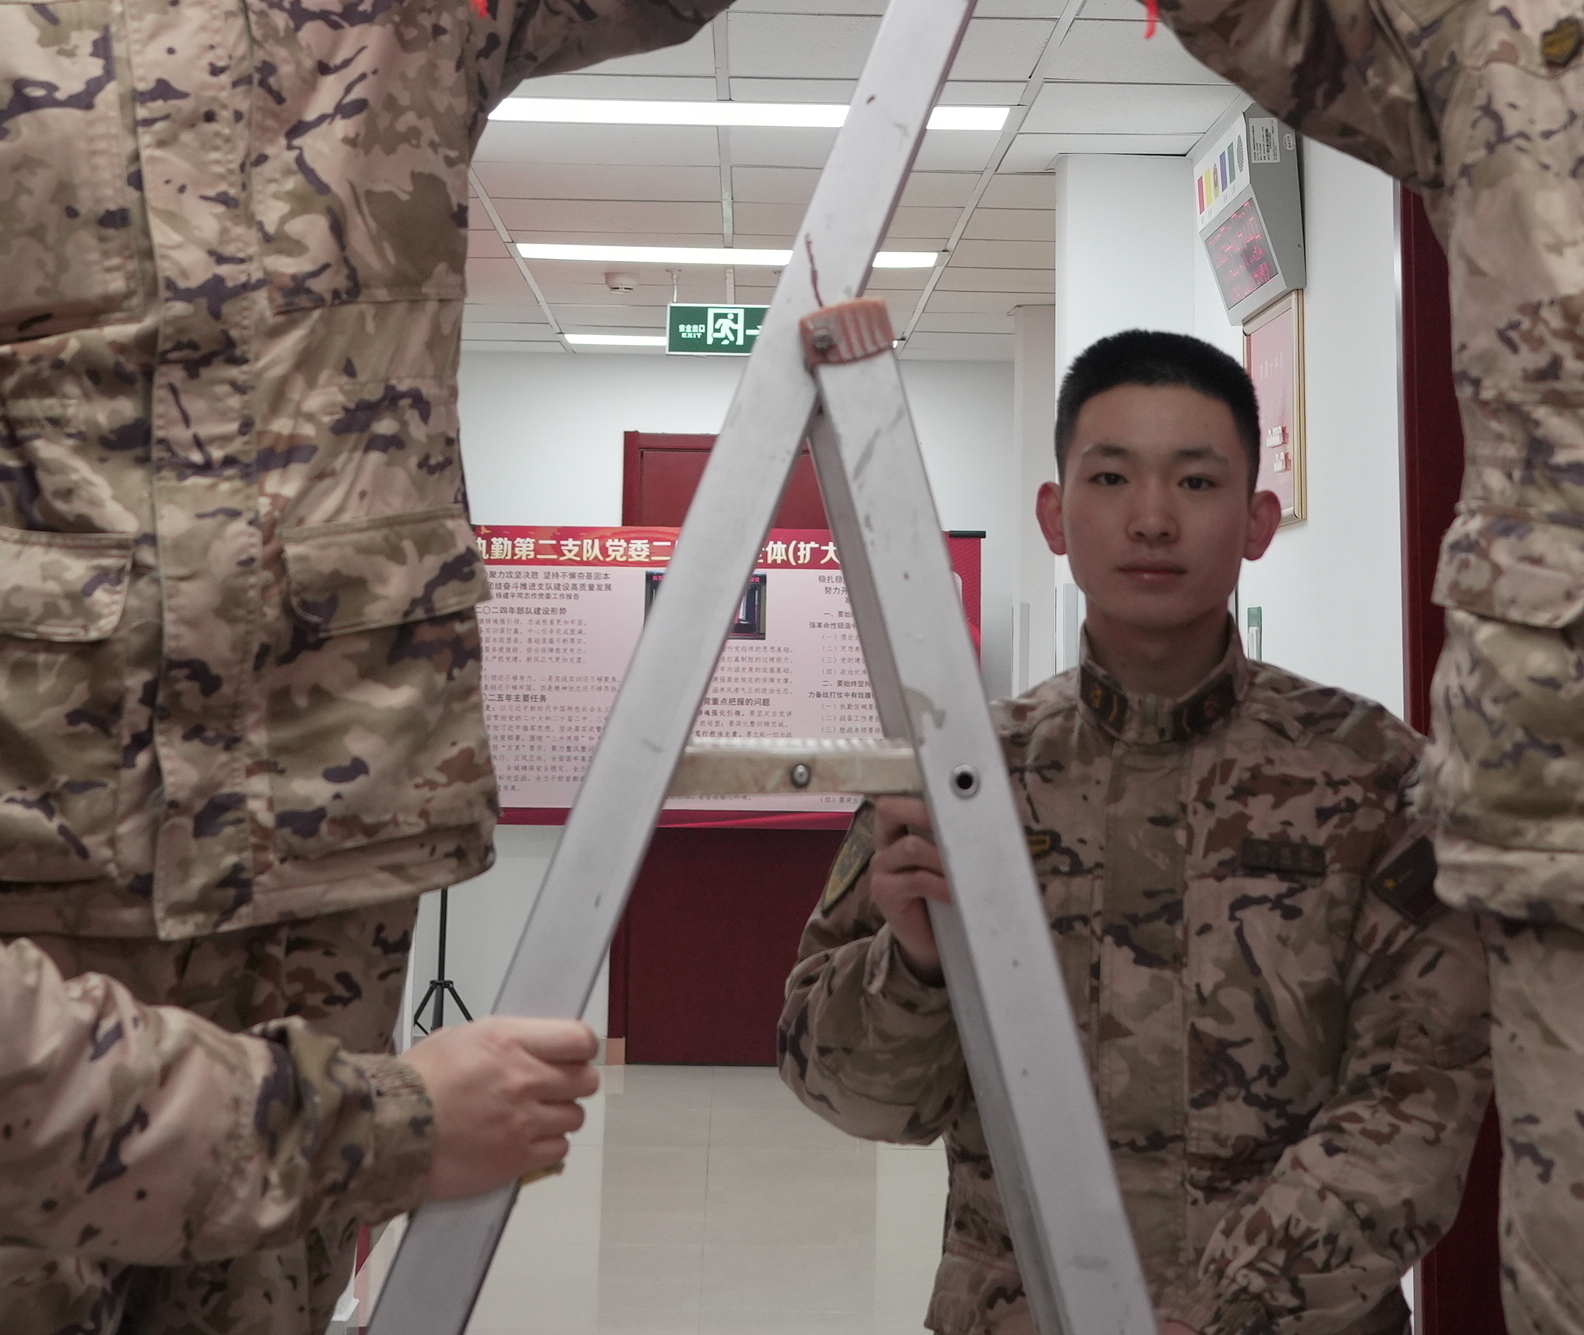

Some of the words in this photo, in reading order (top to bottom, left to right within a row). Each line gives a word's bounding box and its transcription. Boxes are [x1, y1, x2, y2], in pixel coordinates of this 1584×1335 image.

[678, 324, 706, 333] 安全出口
[476, 536, 679, 562] 勤第二支队党委二
[485, 570, 539, 581] 聚力攻坚决胜
[818, 575, 846, 584] 稳扎稳
